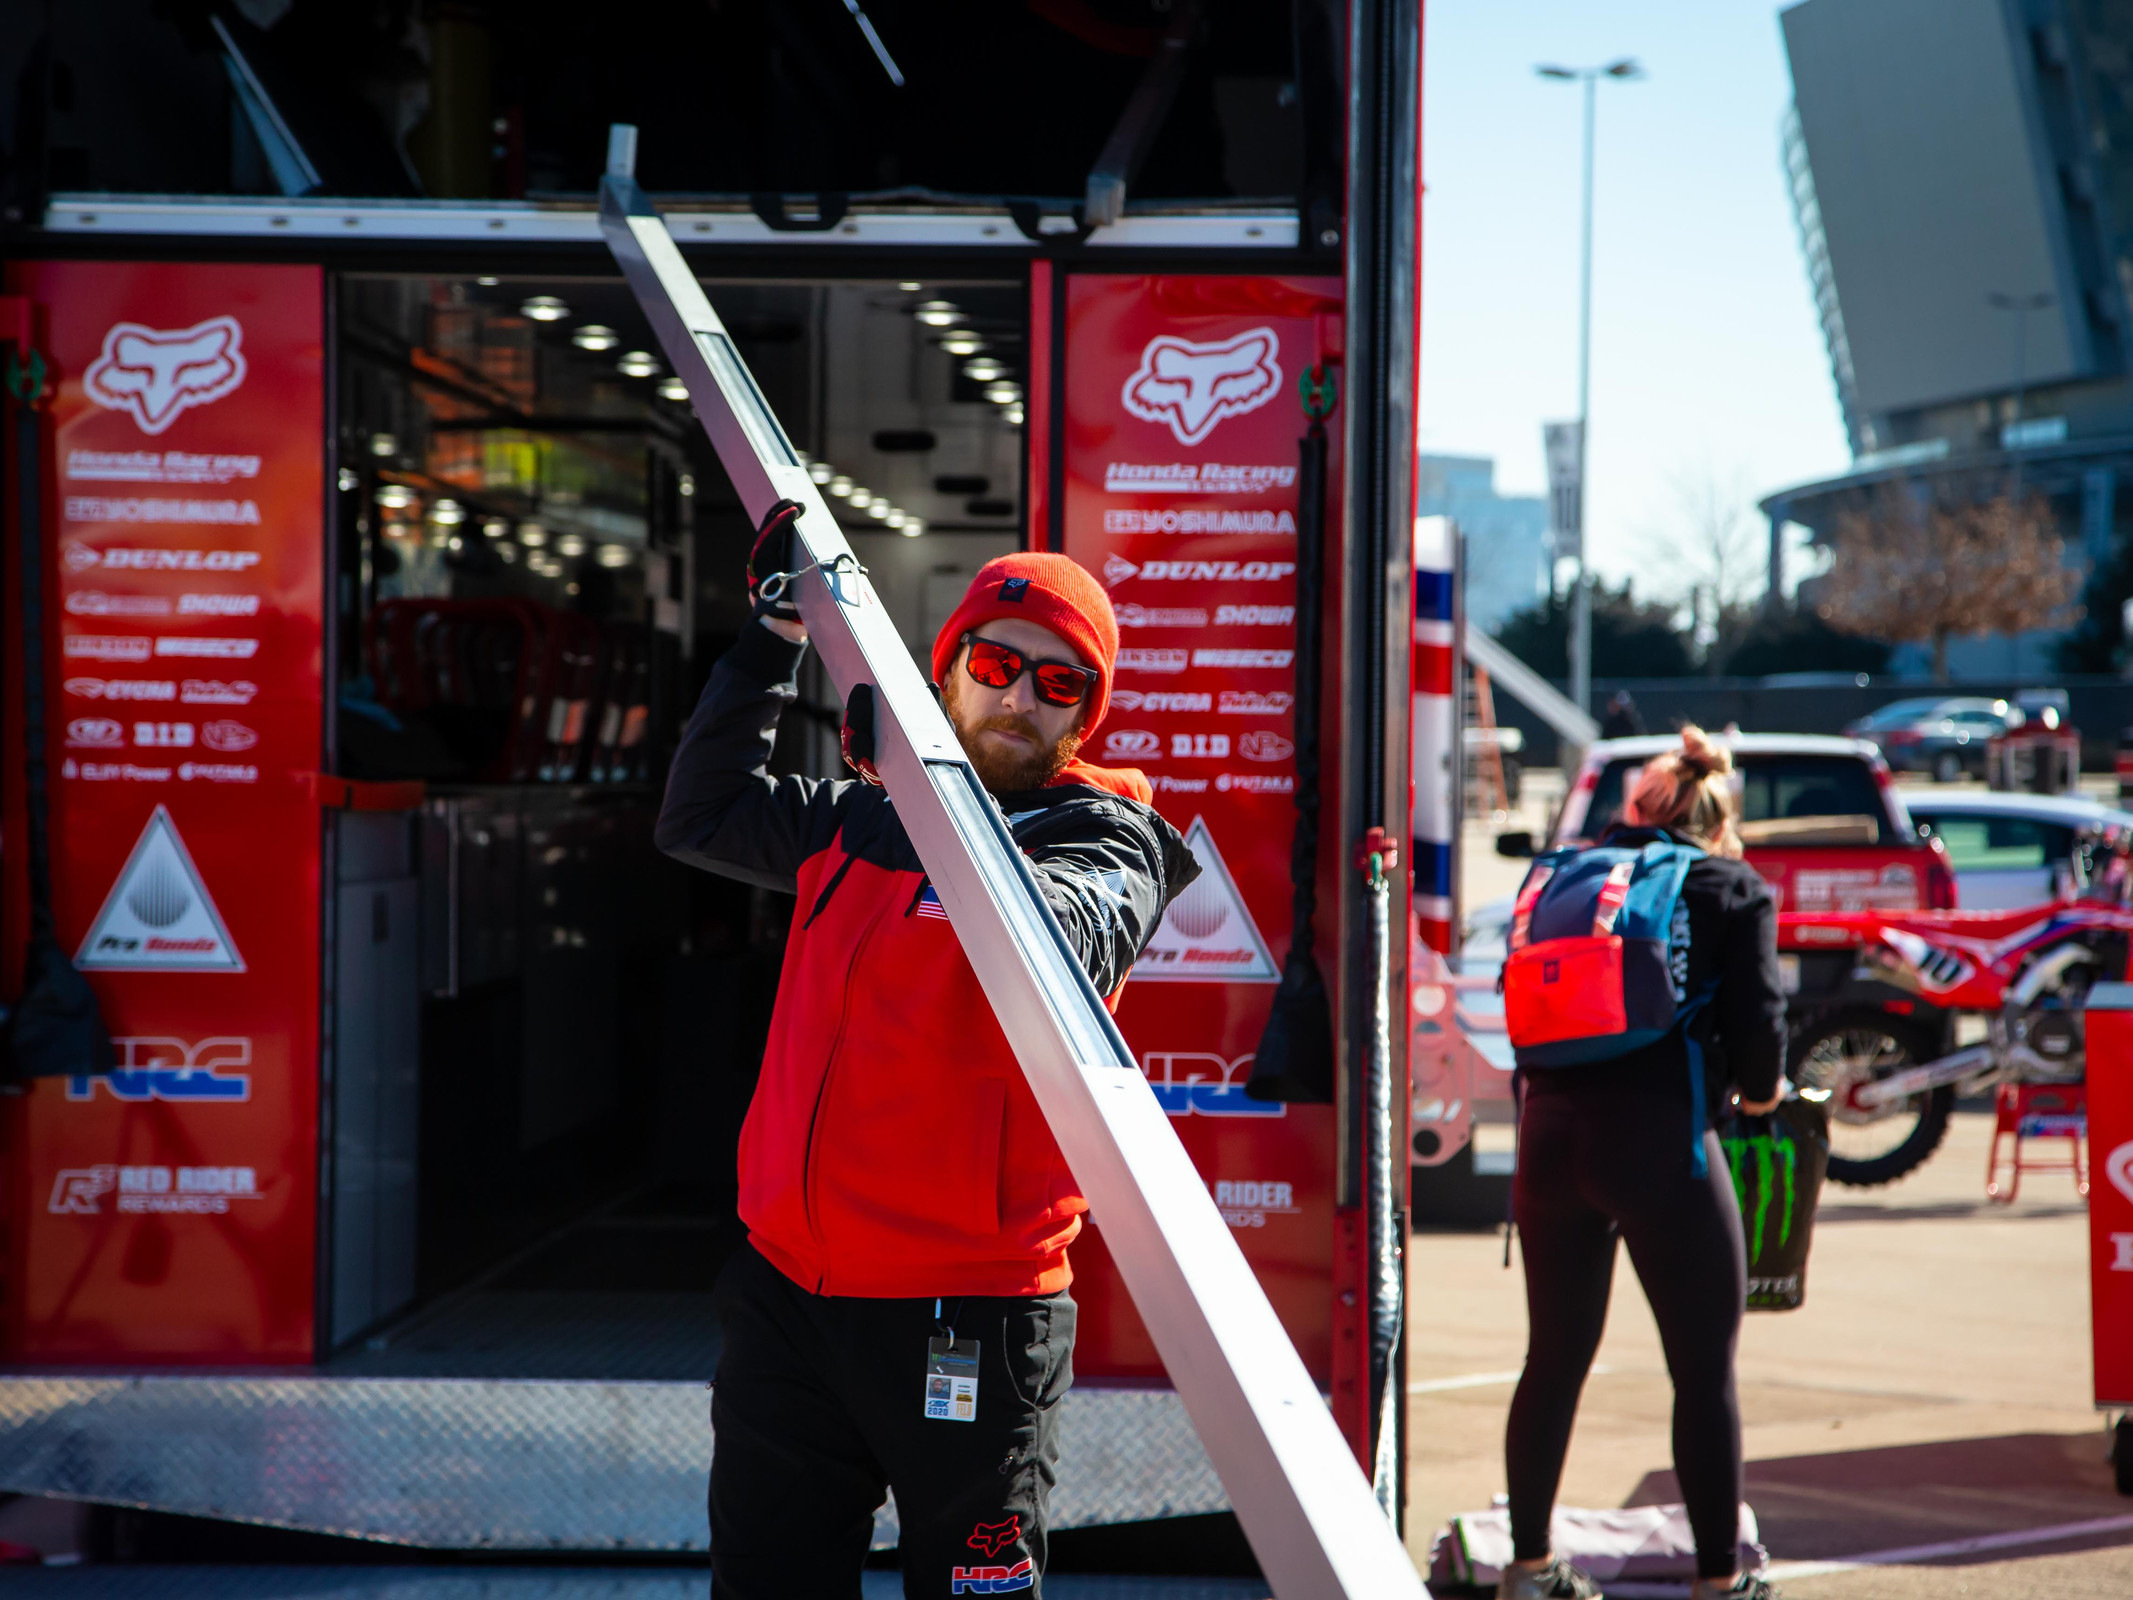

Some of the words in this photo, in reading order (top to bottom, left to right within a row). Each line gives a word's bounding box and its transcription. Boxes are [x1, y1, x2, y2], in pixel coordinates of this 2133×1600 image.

[67, 450, 161, 470] Honda
[163, 452, 261, 478] Racing
[1106, 462, 1198, 480] Honda
[1200, 463, 1296, 487] Racing
[1142, 510, 1296, 534] YOSHIMURA
[102, 548, 261, 571] DUNLOP
[1138, 561, 1296, 581] DUNLOP
[1213, 605, 1296, 626] SHOWA
[1160, 775, 1209, 792] Power
[1231, 775, 1293, 794] YUTAKA
[99, 935, 140, 953] Pro
[1142, 948, 1177, 962] Pro
[1181, 947, 1256, 964] Honda
[119, 1165, 172, 1193] RED
[176, 1165, 256, 1194] RIDER
[1215, 1180, 1293, 1208] RIDER
[927, 1407, 948, 1417] 2020
[952, 1557, 1033, 1594] HRC
